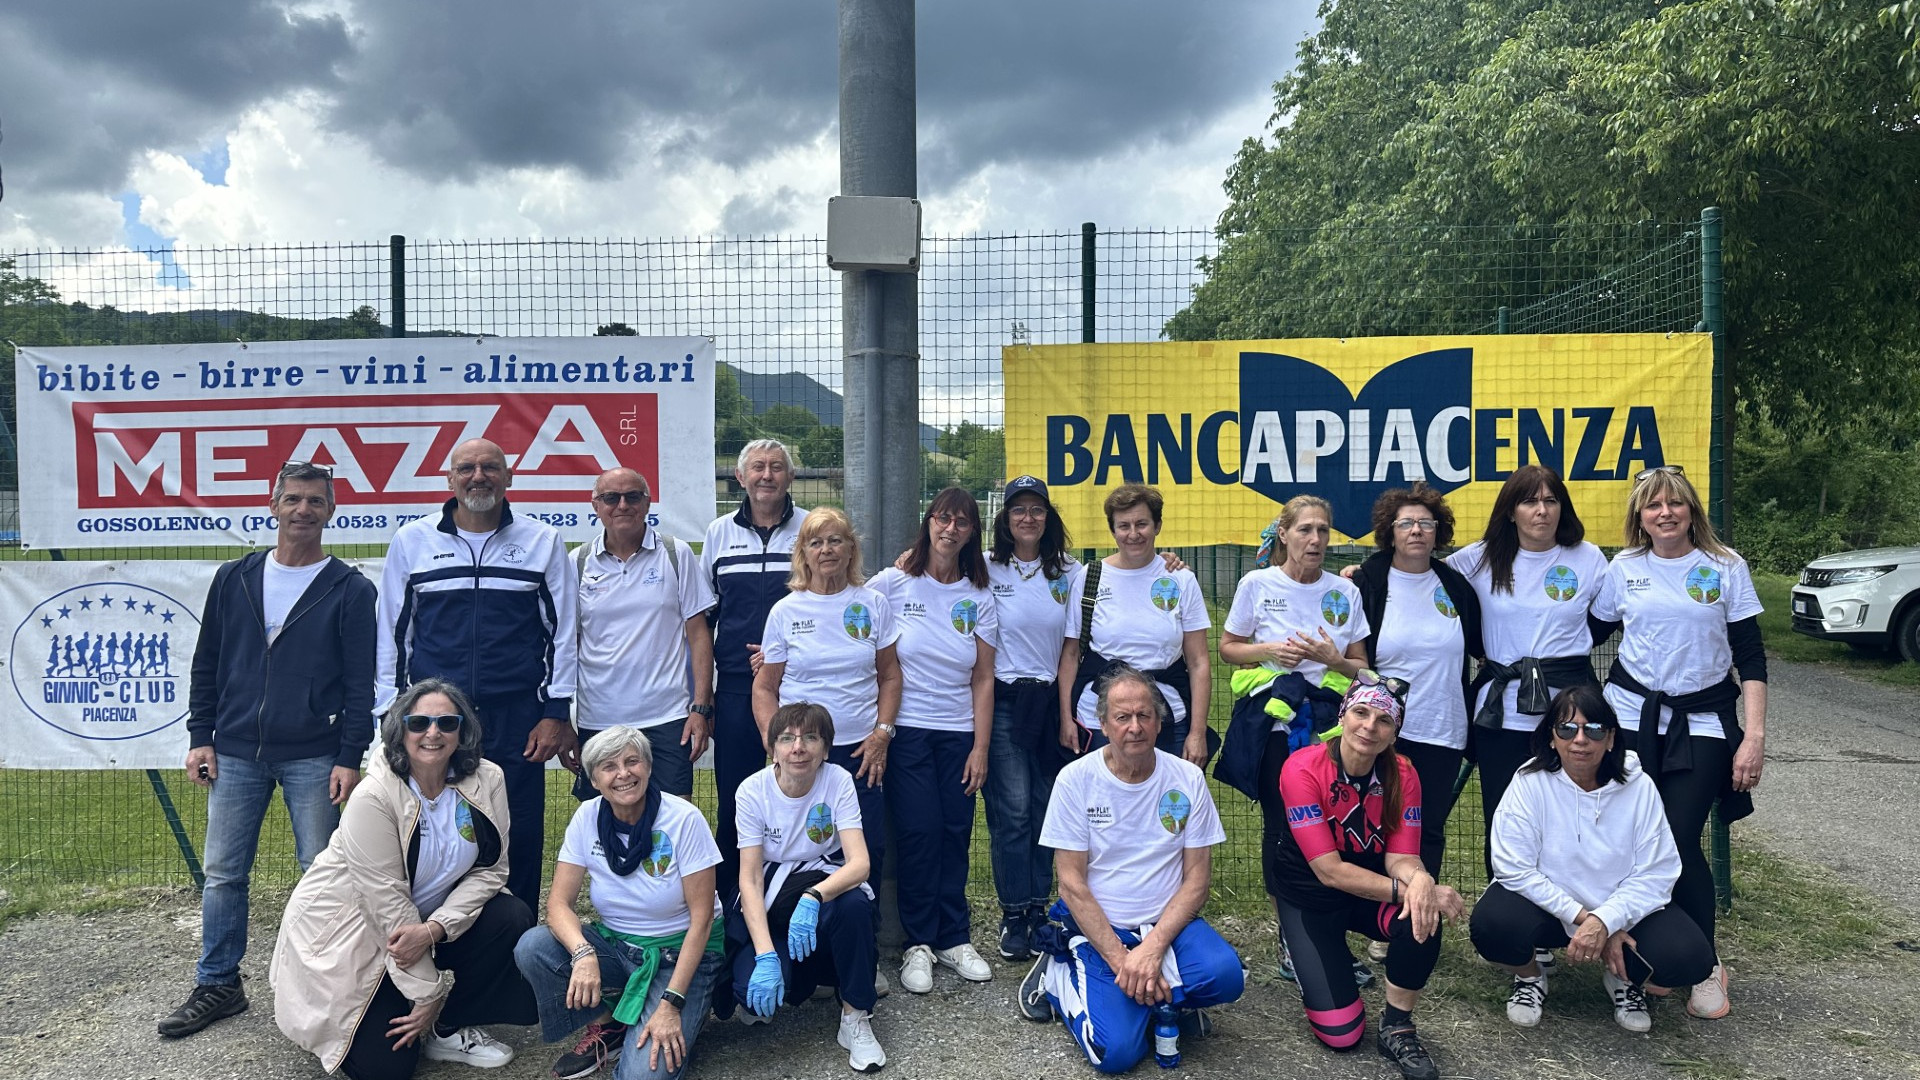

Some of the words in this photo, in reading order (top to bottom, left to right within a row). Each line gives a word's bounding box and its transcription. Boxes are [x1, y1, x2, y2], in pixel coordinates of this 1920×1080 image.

[37, 364, 160, 391] bibite
[199, 360, 304, 389] birre
[340, 355, 427, 385] vini
[464, 354, 695, 384] alimentari
[93, 404, 623, 497] MEAZZA
[1047, 406, 1666, 486] BANCAPIACENZA
[77, 516, 232, 533] GOSSOLENGO
[119, 680, 176, 704] CLUB
[82, 707, 138, 722] PIACENZA
